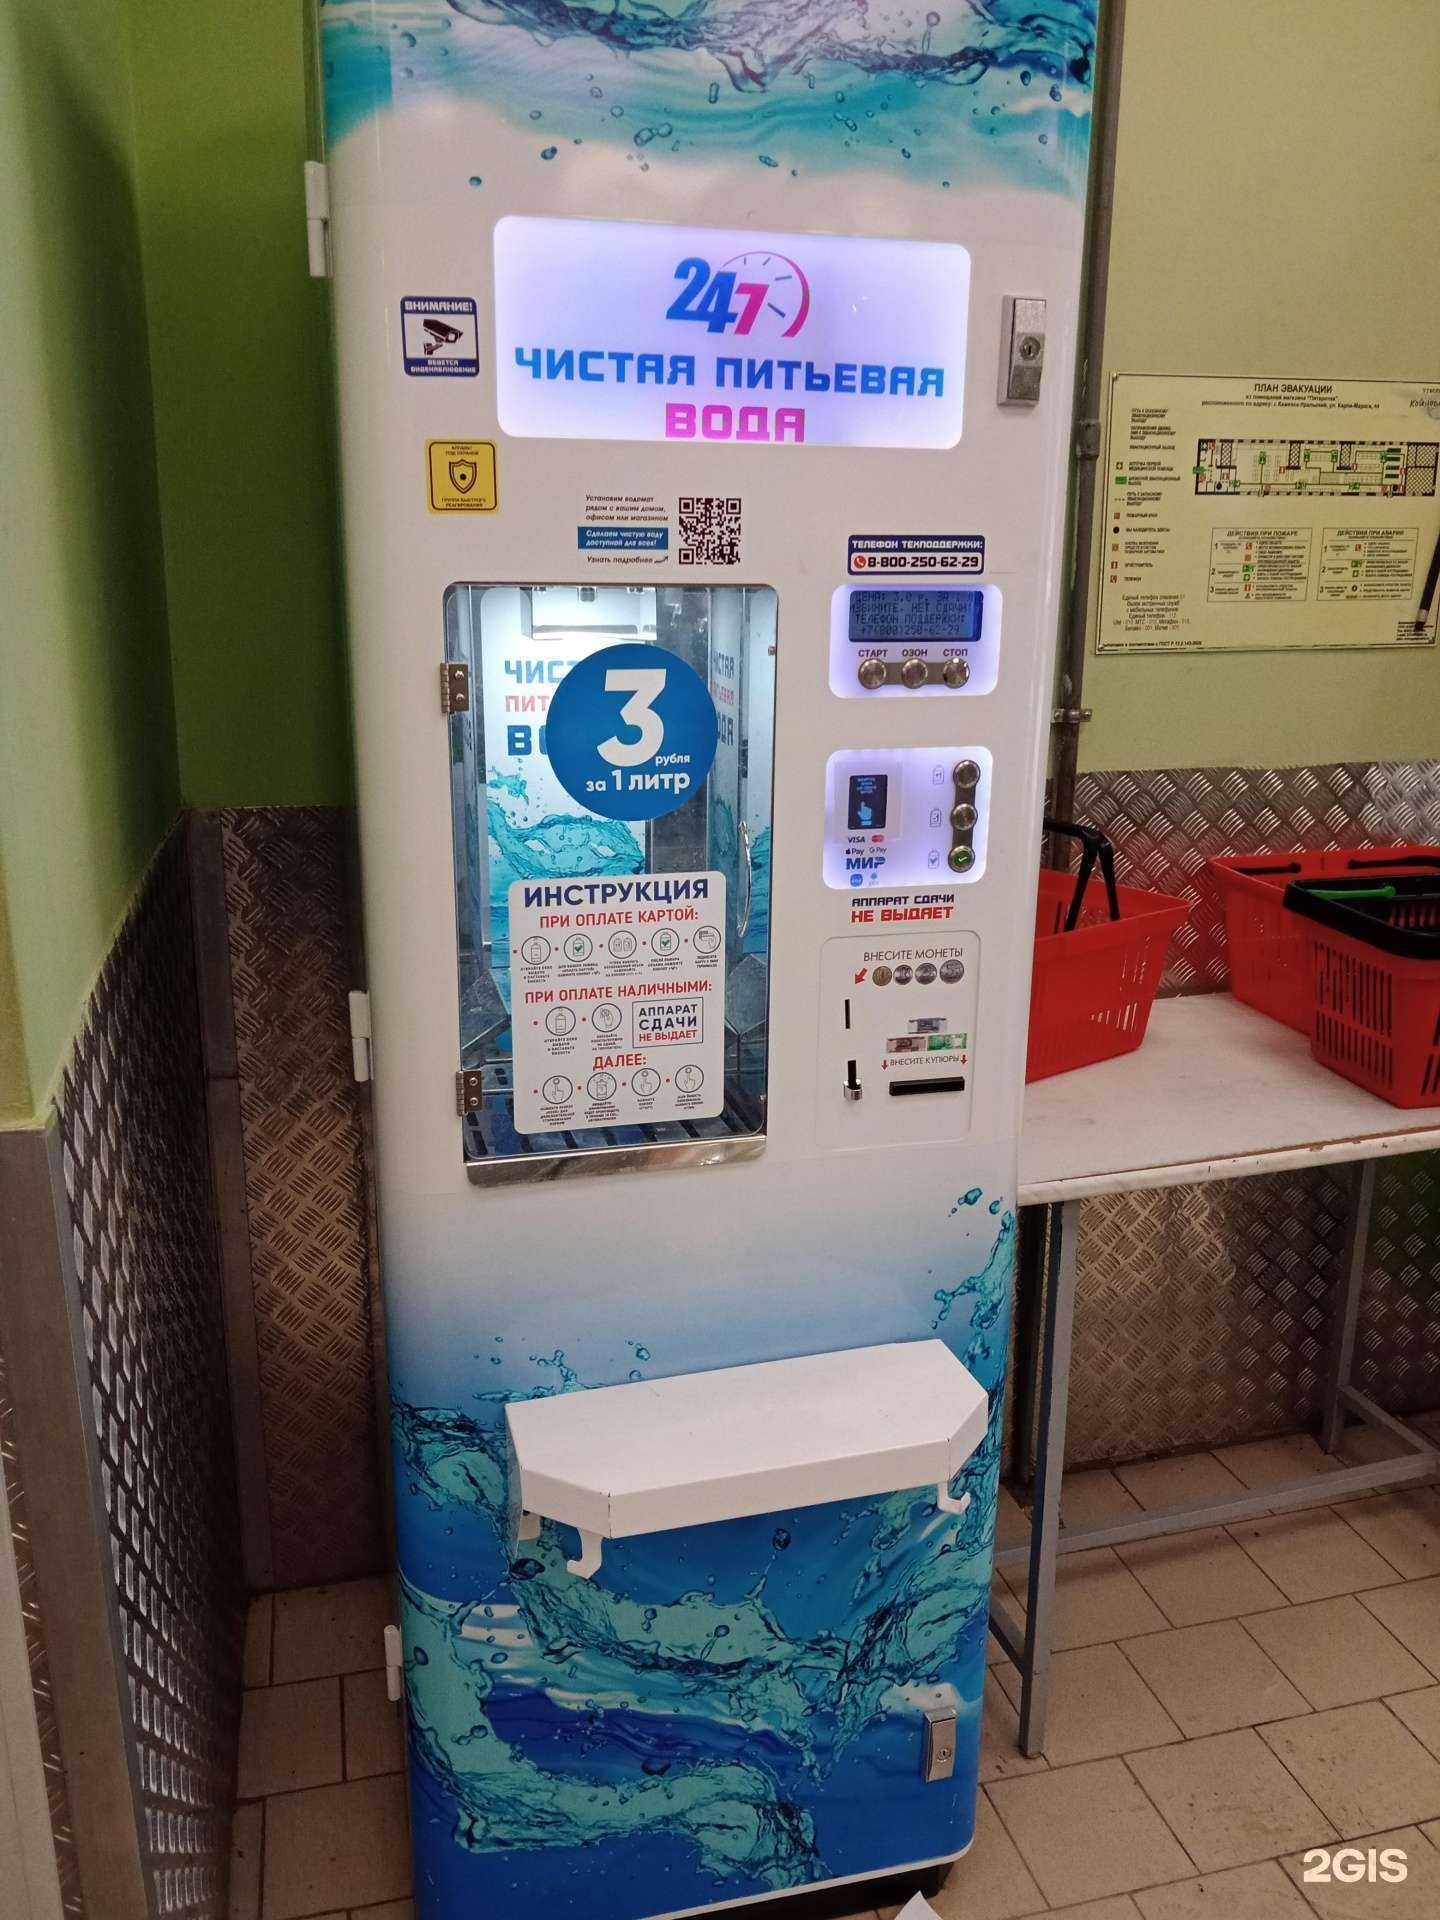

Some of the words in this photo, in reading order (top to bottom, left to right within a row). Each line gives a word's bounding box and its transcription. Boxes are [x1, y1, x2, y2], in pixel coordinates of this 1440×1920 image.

[404, 301, 472, 312] ВНИМАНИЕ!
[514, 347, 695, 386] ЧИСТАЯ
[716, 356, 945, 397] ПИТЬЕВАЯ
[1254, 384, 1279, 392] ПЛАН
[1280, 384, 1333, 394] ЭВАКУАЦИИ
[665, 402, 806, 443] ВОДА
[852, 540, 899, 549] ТЕЛЕФОН
[902, 540, 983, 549] ТЕХПОДДЕРЖКИ:
[868, 556, 979, 568] 8-800-250-62-29
[858, 649, 888, 657] СТАРТ
[902, 649, 928, 657] ОЗОН
[943, 648, 968, 657] СТОП
[504, 659, 574, 684] ЧИС
[597, 668, 667, 767] 3
[655, 753, 690, 767] рубля
[586, 780, 606, 792] за
[611, 769, 622, 791] 1
[628, 773, 690, 794] литр
[851, 848, 865, 856] Pay
[846, 856, 886, 870] МИР
[524, 878, 709, 908] ИНСТРУКЦИЯ
[852, 895, 910, 907] АППАРАТ
[914, 894, 955, 904] СДАЧИ
[540, 914, 570, 929] ПРИ
[576, 911, 633, 927] ОПЛАТЕ
[638, 905, 699, 923] КАРТОЙ:
[851, 910, 874, 923] НЕ
[881, 906, 954, 922] ВЫДАЕТ
[863, 949, 912, 962] ВНЕСИТЕ
[915, 947, 963, 959] МОНЕТЫ
[525, 989, 554, 1004] ПРИ
[559, 985, 613, 1001] ОПЛАТЕ
[618, 979, 713, 998] НАЛИЧНЫМИ:
[638, 1003, 698, 1018] АППАРАТ
[638, 1016, 698, 1032] СДАЧИ
[639, 1031, 653, 1043] НЕ
[655, 1029, 698, 1042] ВЫДАЕТ
[593, 1053, 647, 1071] ДАЛЕЕ:
[889, 1056, 924, 1066] ВНЕСИТЕ
[925, 1055, 960, 1065] КУПЮРЫ
